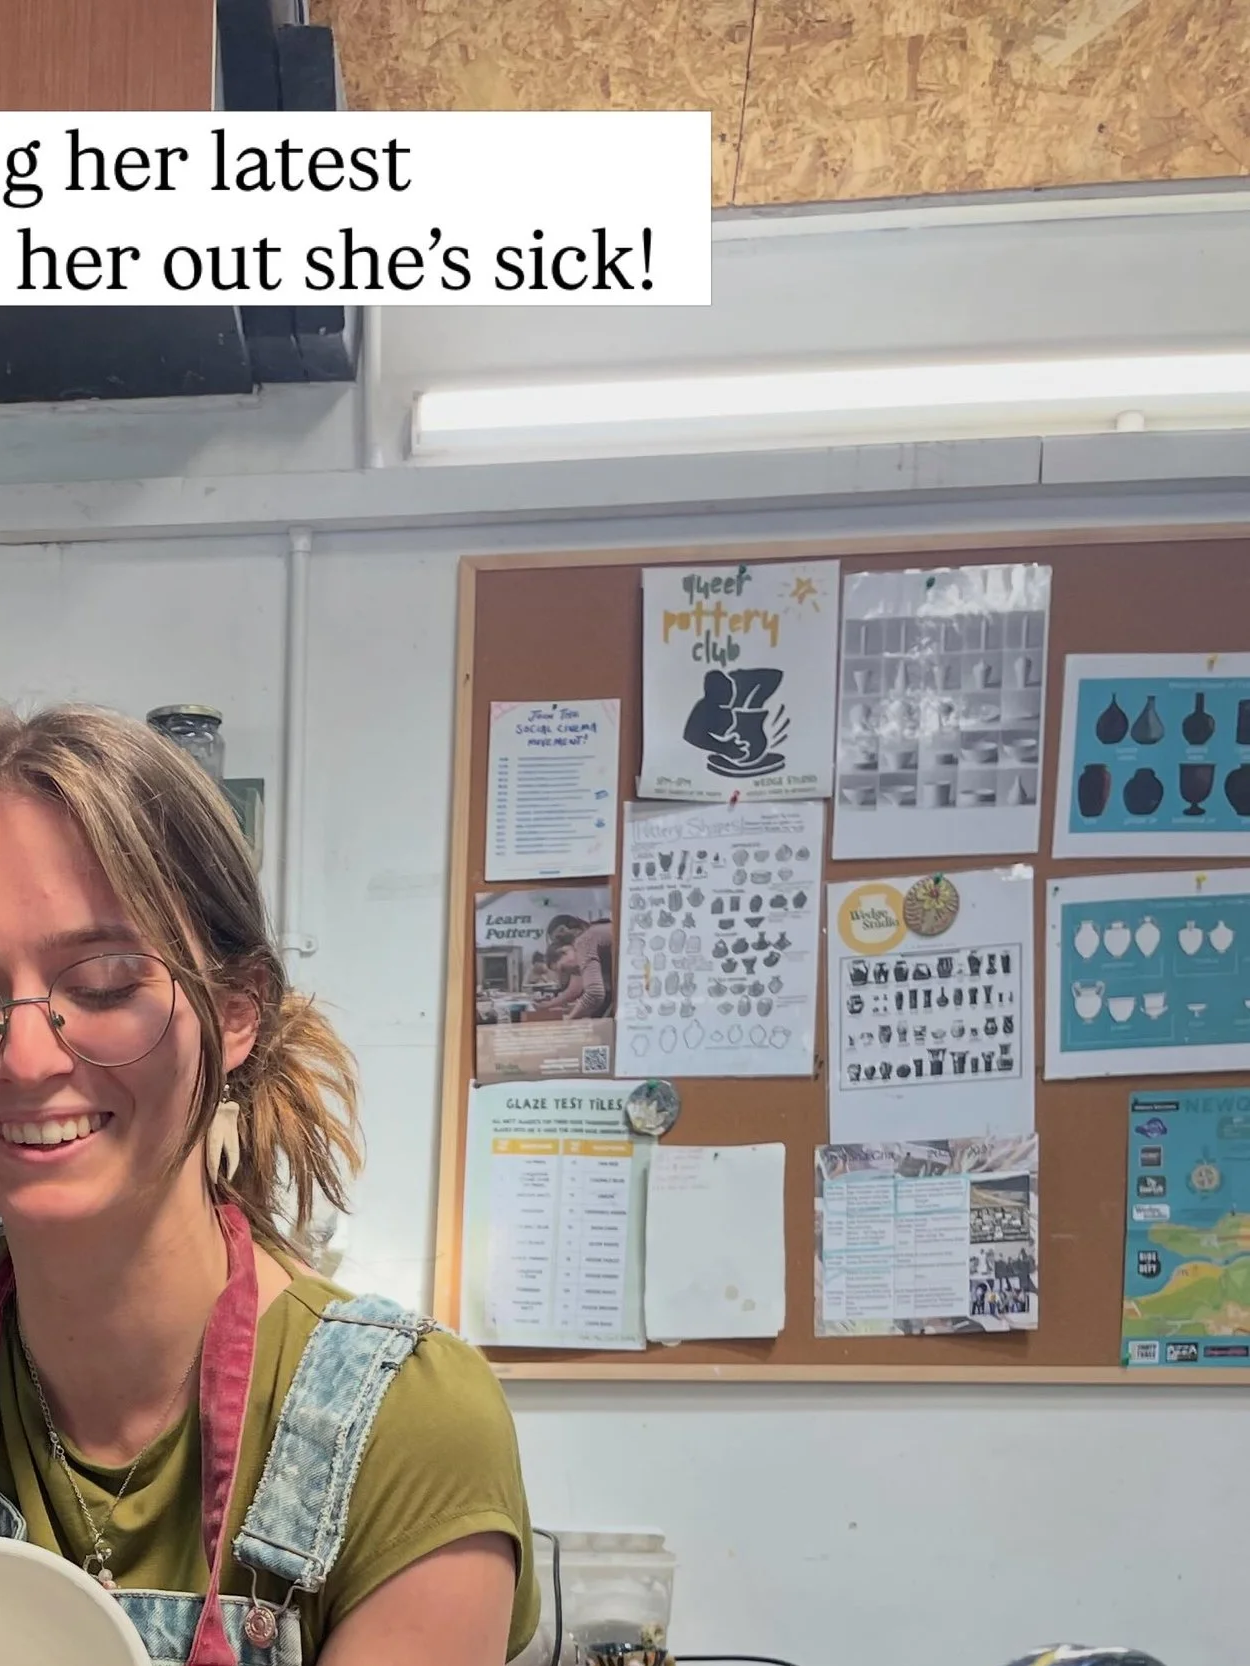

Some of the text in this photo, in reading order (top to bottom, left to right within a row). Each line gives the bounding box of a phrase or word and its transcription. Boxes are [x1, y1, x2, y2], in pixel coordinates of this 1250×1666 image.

[682, 573, 752, 605] queer
[663, 601, 779, 648] pottery
[692, 630, 740, 667] club
[485, 914, 532, 926] Learn
[850, 908, 888, 922] Wedge
[862, 917, 900, 930] Studio
[485, 927, 544, 940] Pottery
[506, 1098, 547, 1110] GLAZE
[554, 1097, 582, 1110] TEST
